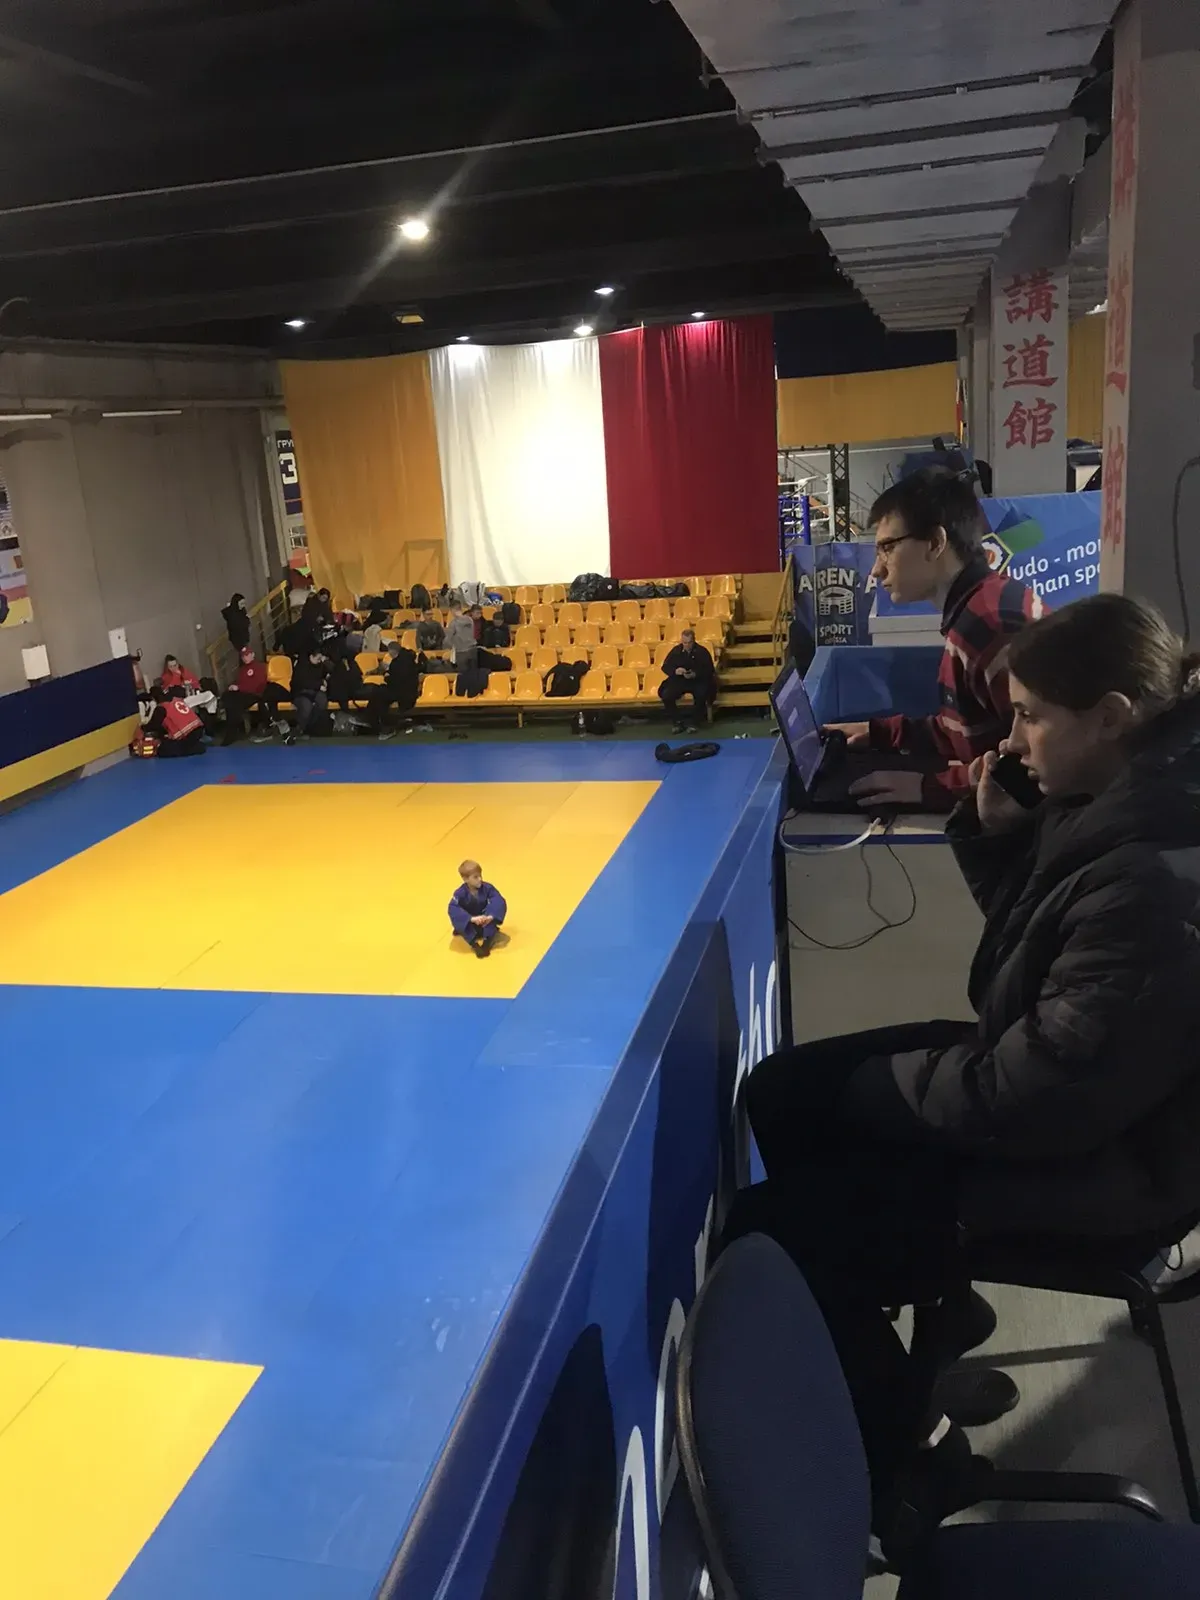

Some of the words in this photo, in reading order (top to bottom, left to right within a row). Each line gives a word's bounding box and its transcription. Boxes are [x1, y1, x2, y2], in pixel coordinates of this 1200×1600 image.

[1002, 267, 1059, 449] 講道館
[279, 452, 298, 484] 3
[1026, 573, 1070, 596] han
[1074, 562, 1101, 585] sp
[819, 623, 854, 637] SPORT
